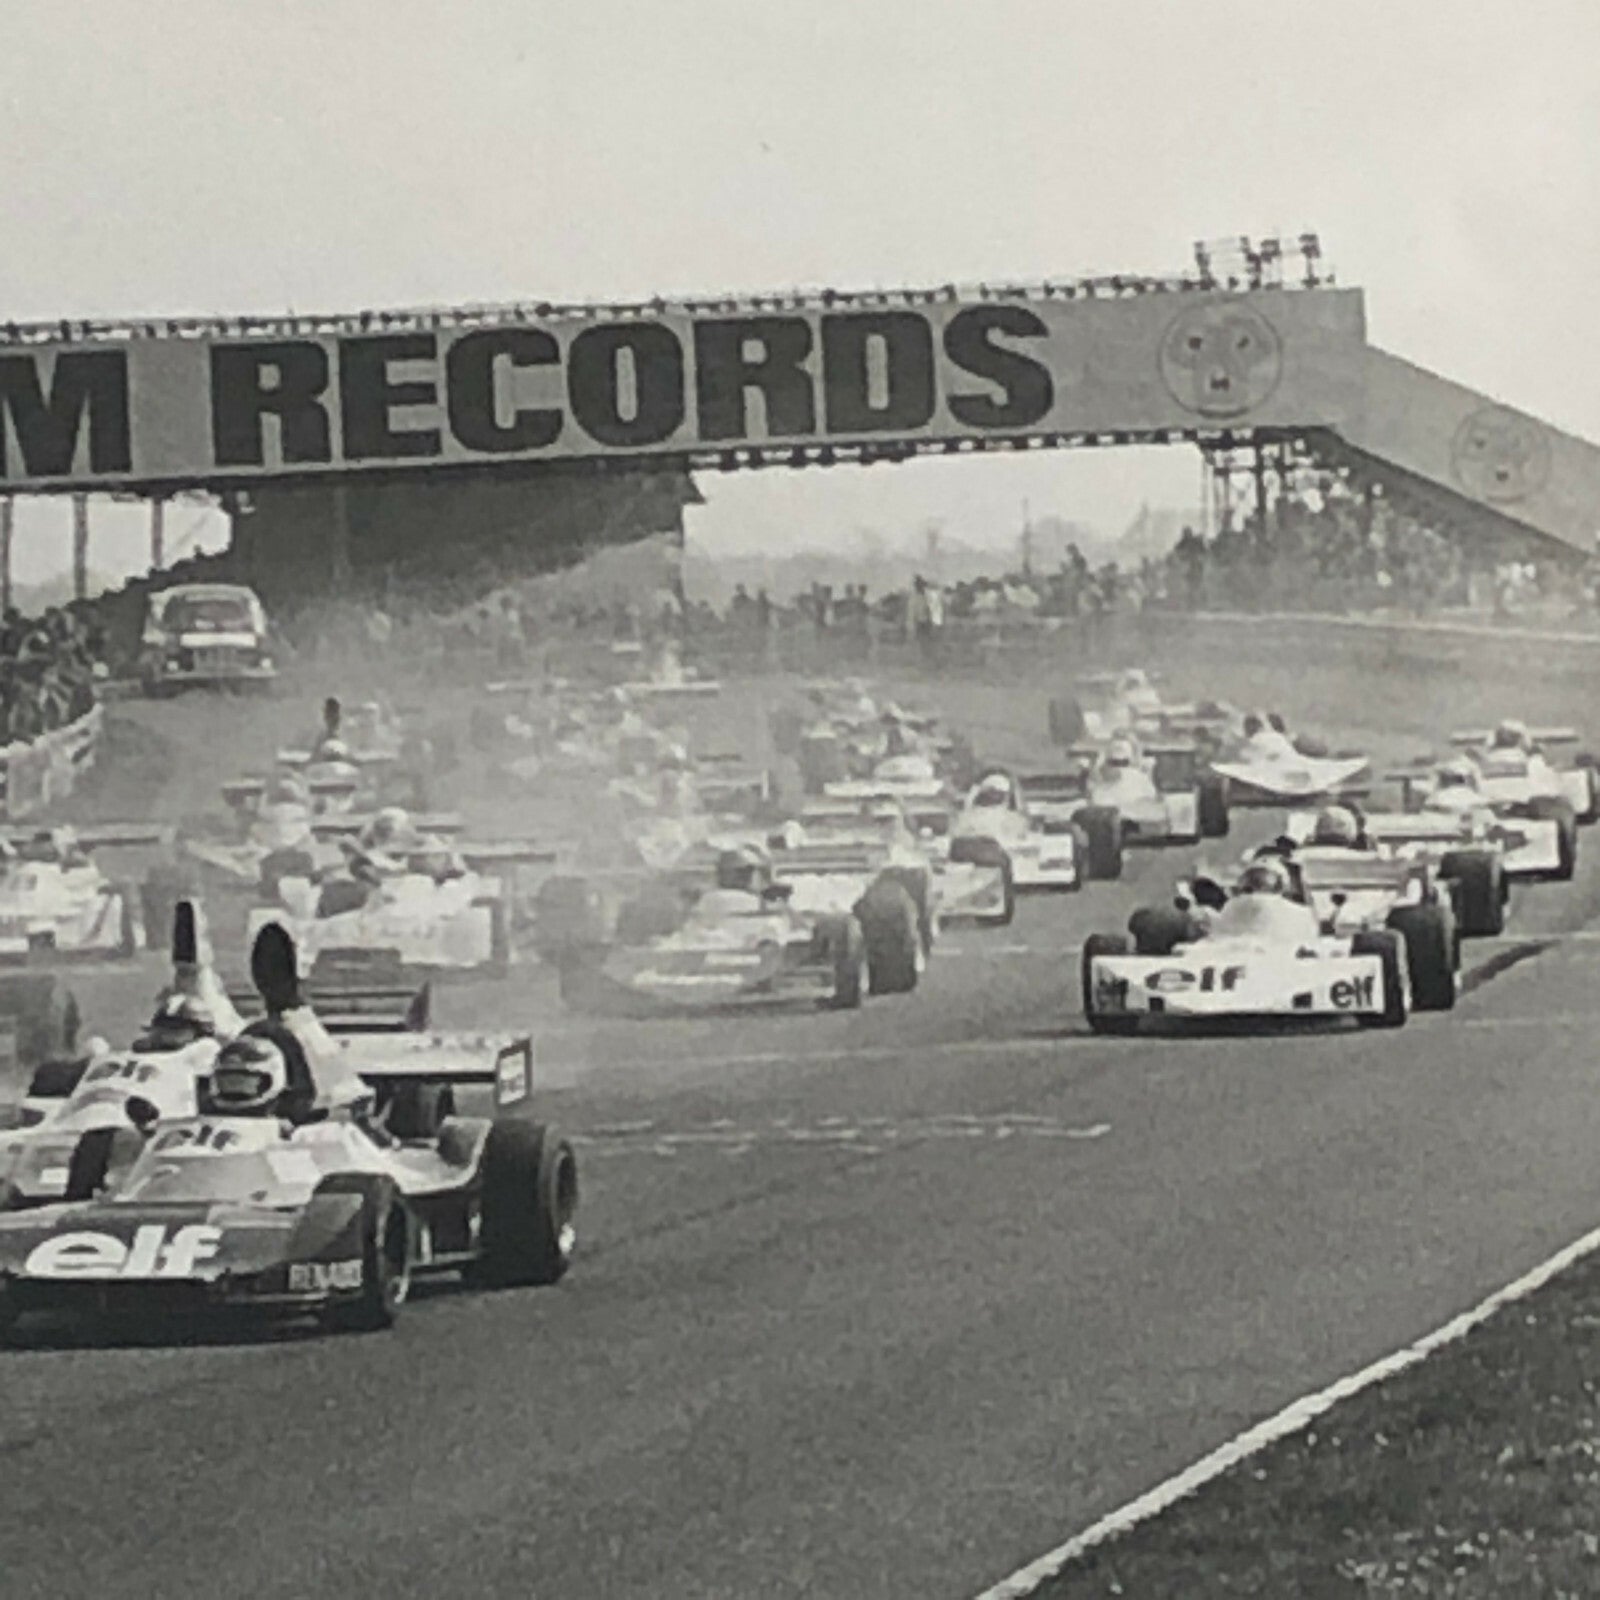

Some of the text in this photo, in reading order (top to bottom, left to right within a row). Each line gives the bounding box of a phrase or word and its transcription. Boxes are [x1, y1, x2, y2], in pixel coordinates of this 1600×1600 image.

[209, 304, 1055, 467] RECORDS
[1144, 965, 1247, 994] elf
[1329, 975, 1375, 1009] elf
[25, 1224, 224, 1278] elf
